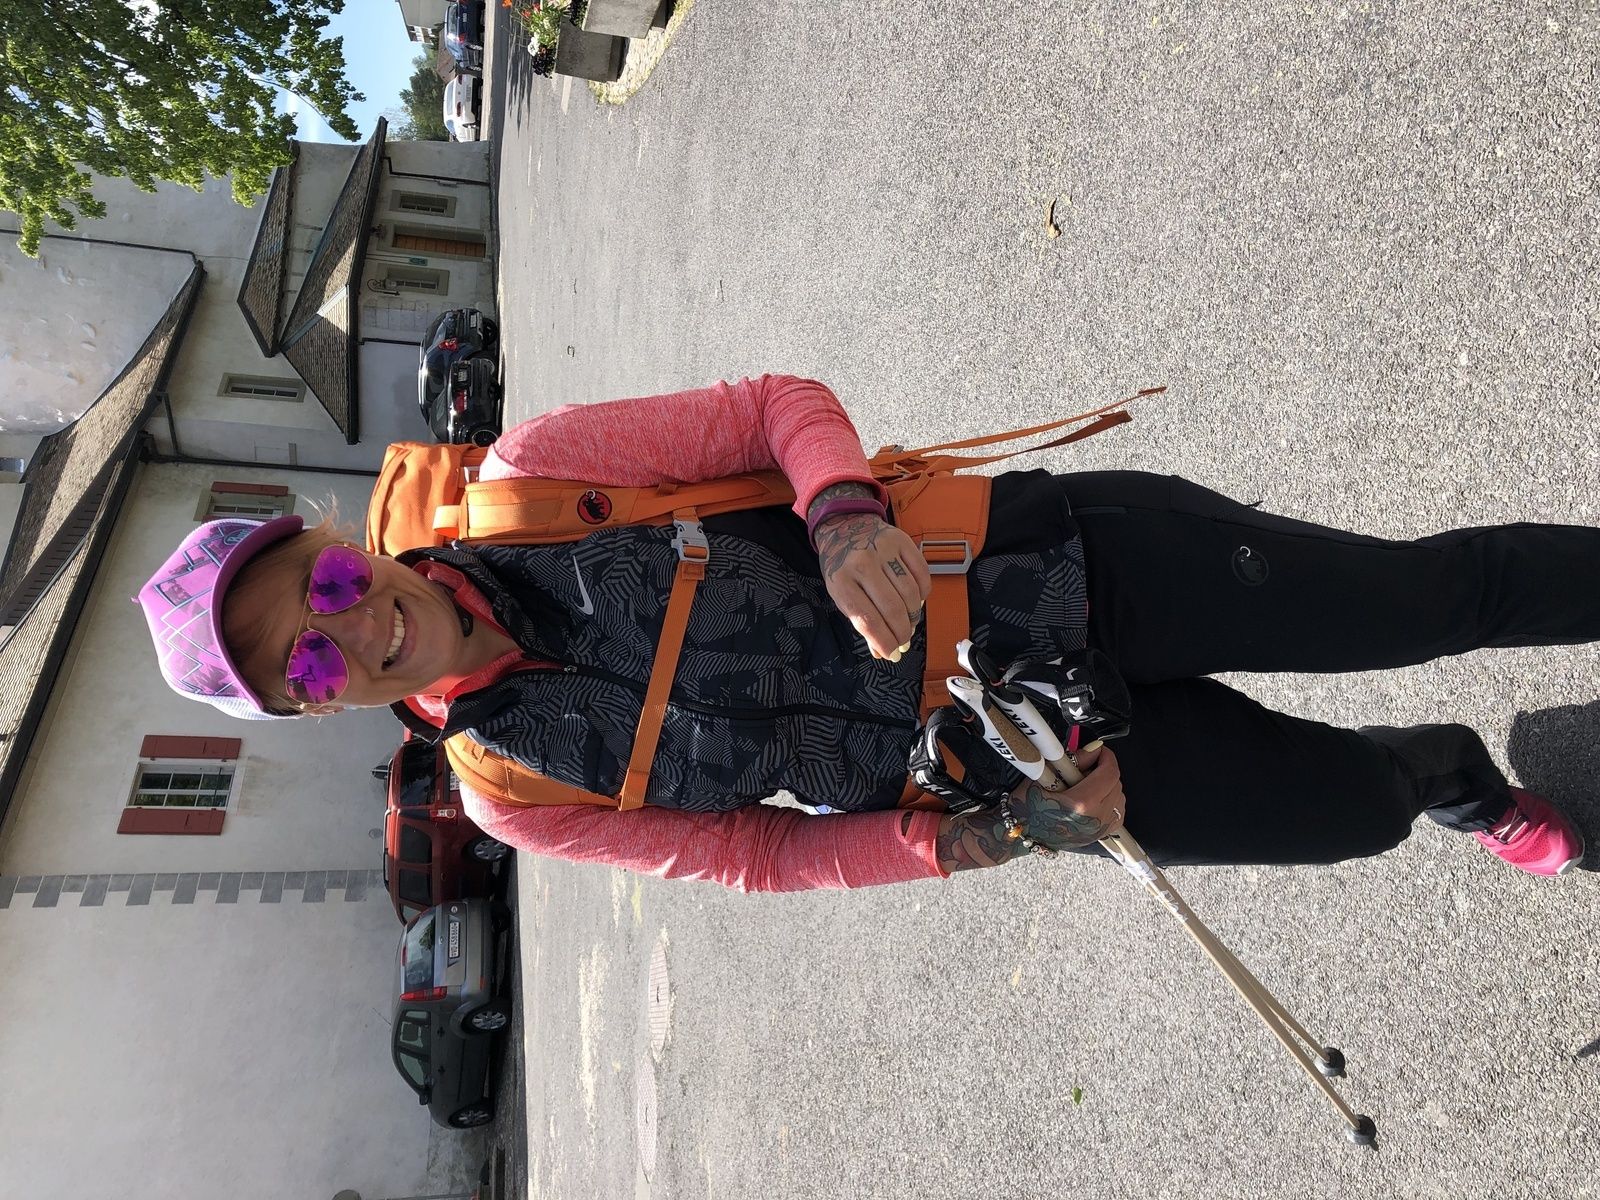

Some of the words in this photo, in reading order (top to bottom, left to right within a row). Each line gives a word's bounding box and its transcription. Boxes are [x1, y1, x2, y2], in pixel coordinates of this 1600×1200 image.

[1002, 707, 1038, 736] LEKI
[989, 737, 1017, 762] LEKI
[910, 769, 953, 797] EKI
